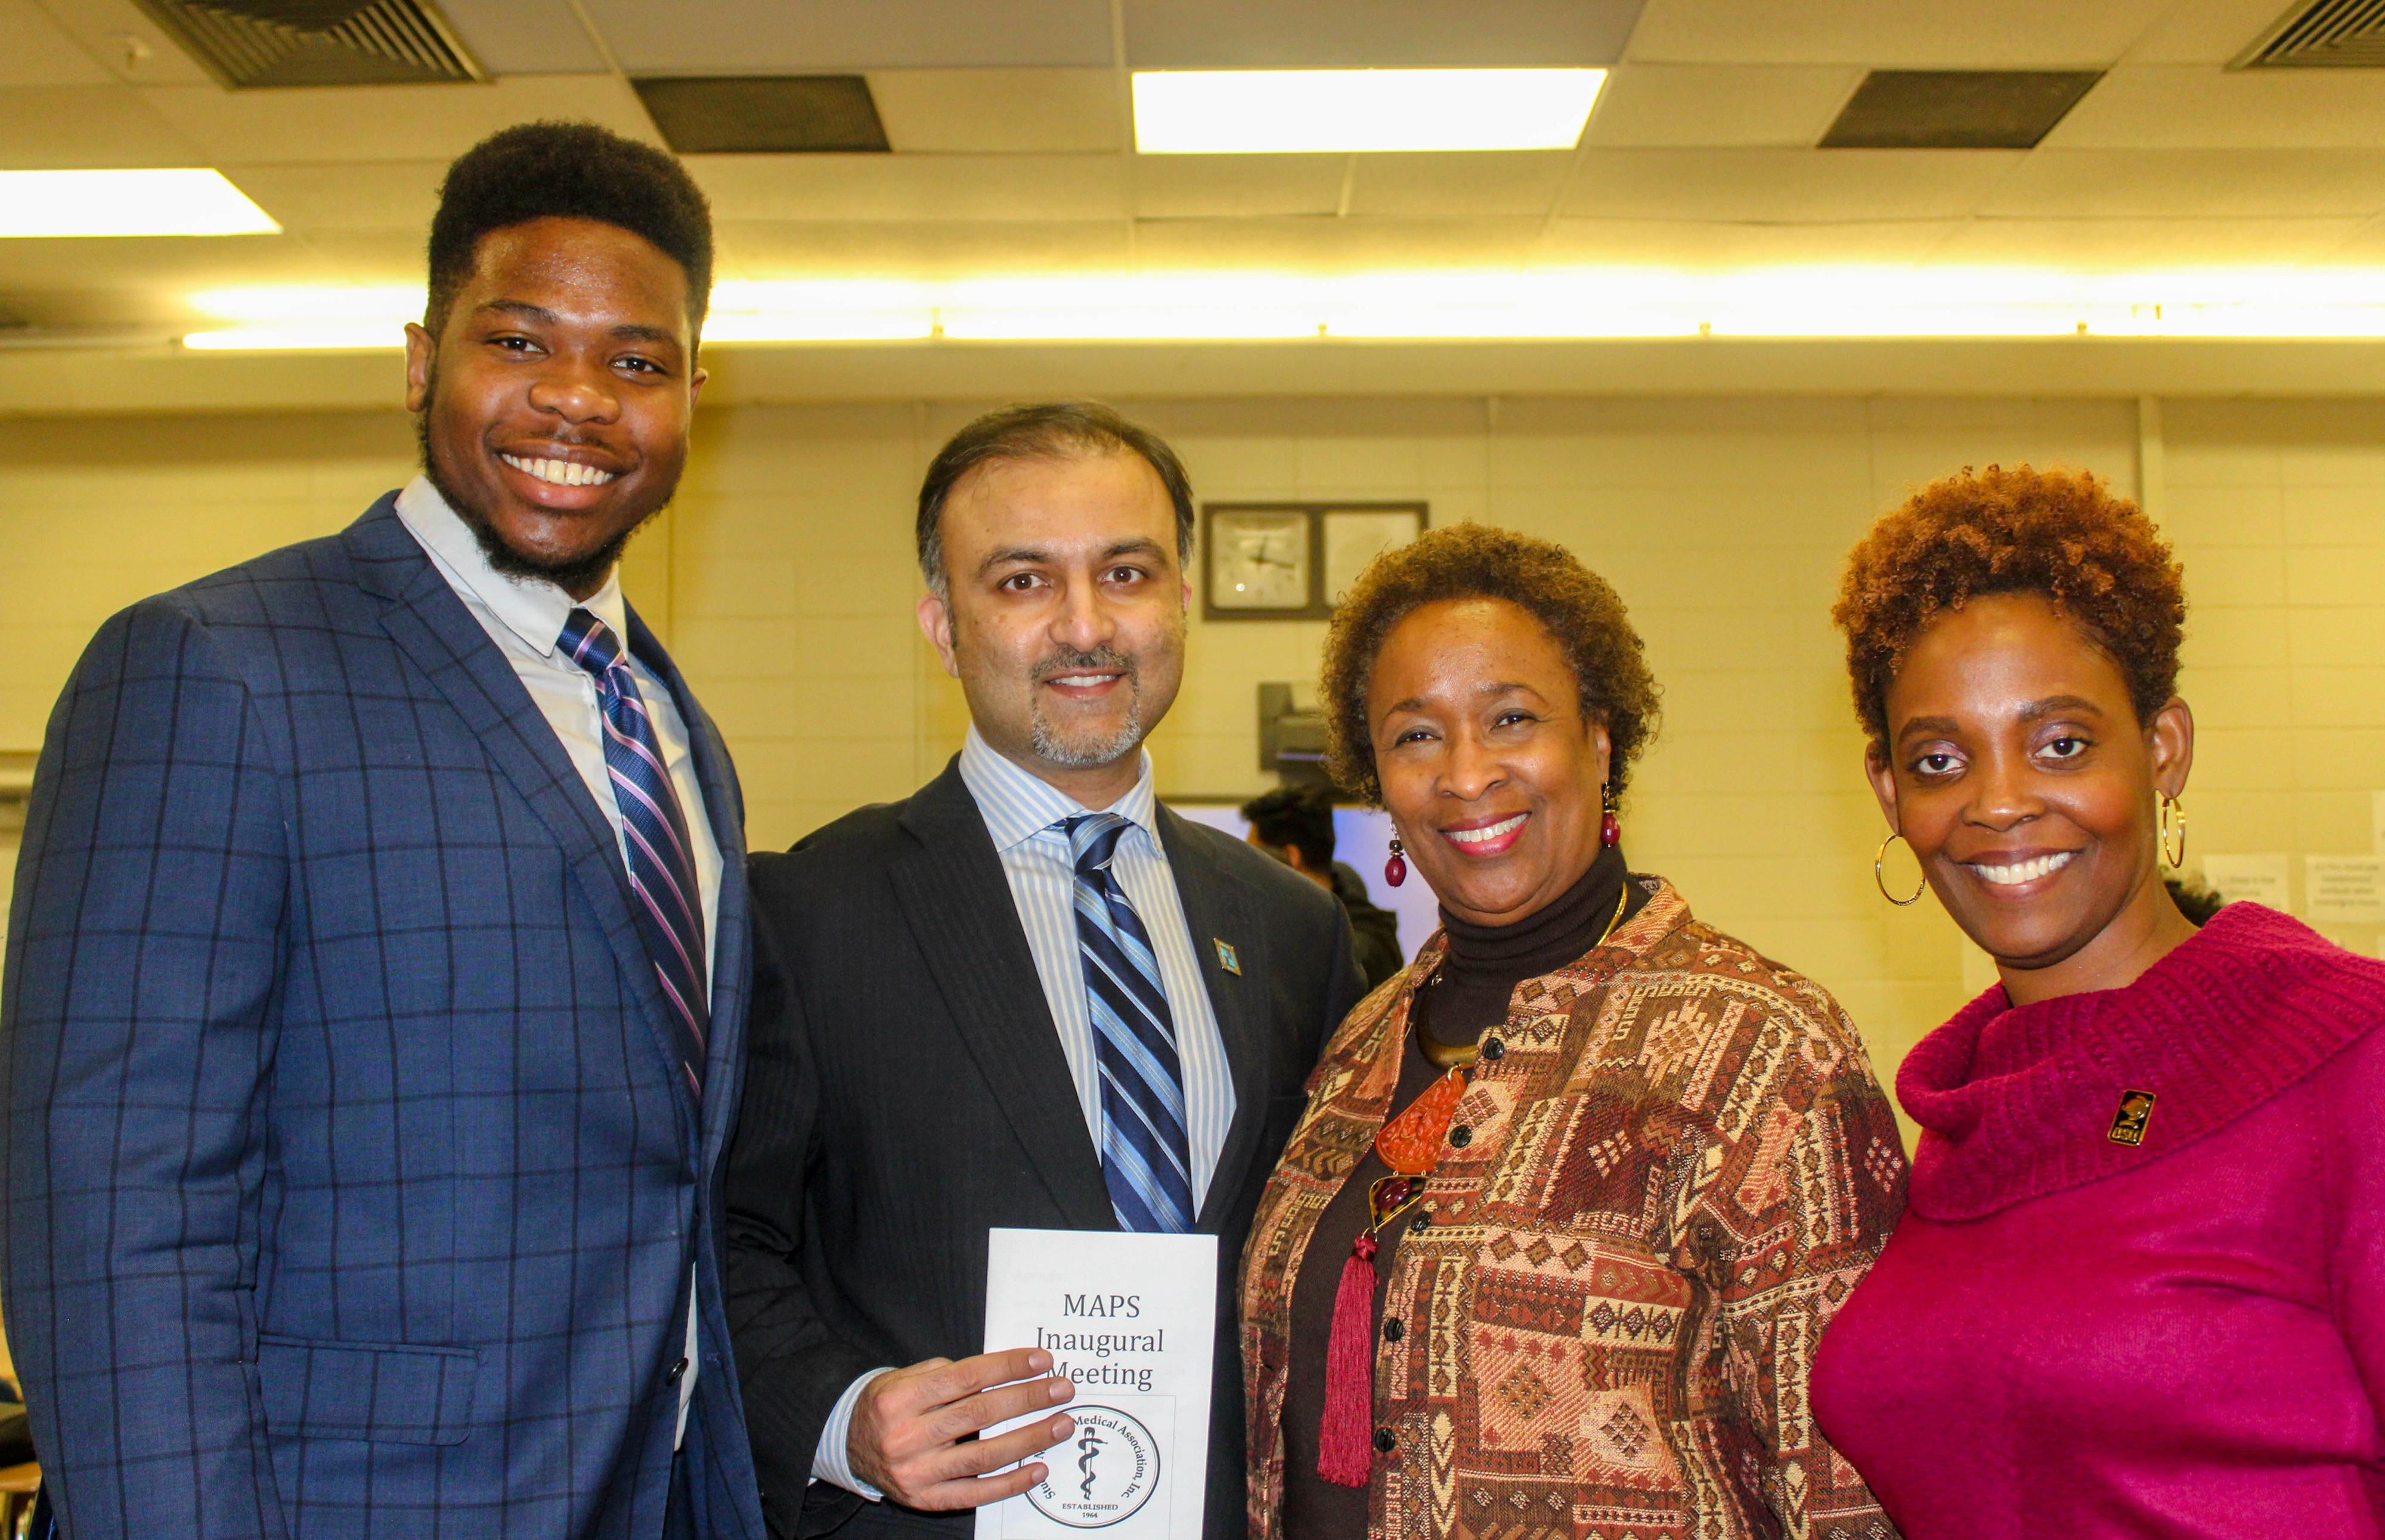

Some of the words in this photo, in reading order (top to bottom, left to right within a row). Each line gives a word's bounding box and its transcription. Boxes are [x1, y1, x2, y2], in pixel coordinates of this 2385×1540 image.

[1063, 1294, 1140, 1318] MAPS
[1036, 1327, 1164, 1358] Inaugural
[1046, 1361, 1153, 1392] Meeting
[1072, 1415, 1119, 1430] Medical
[1117, 1426, 1147, 1480] Association,
